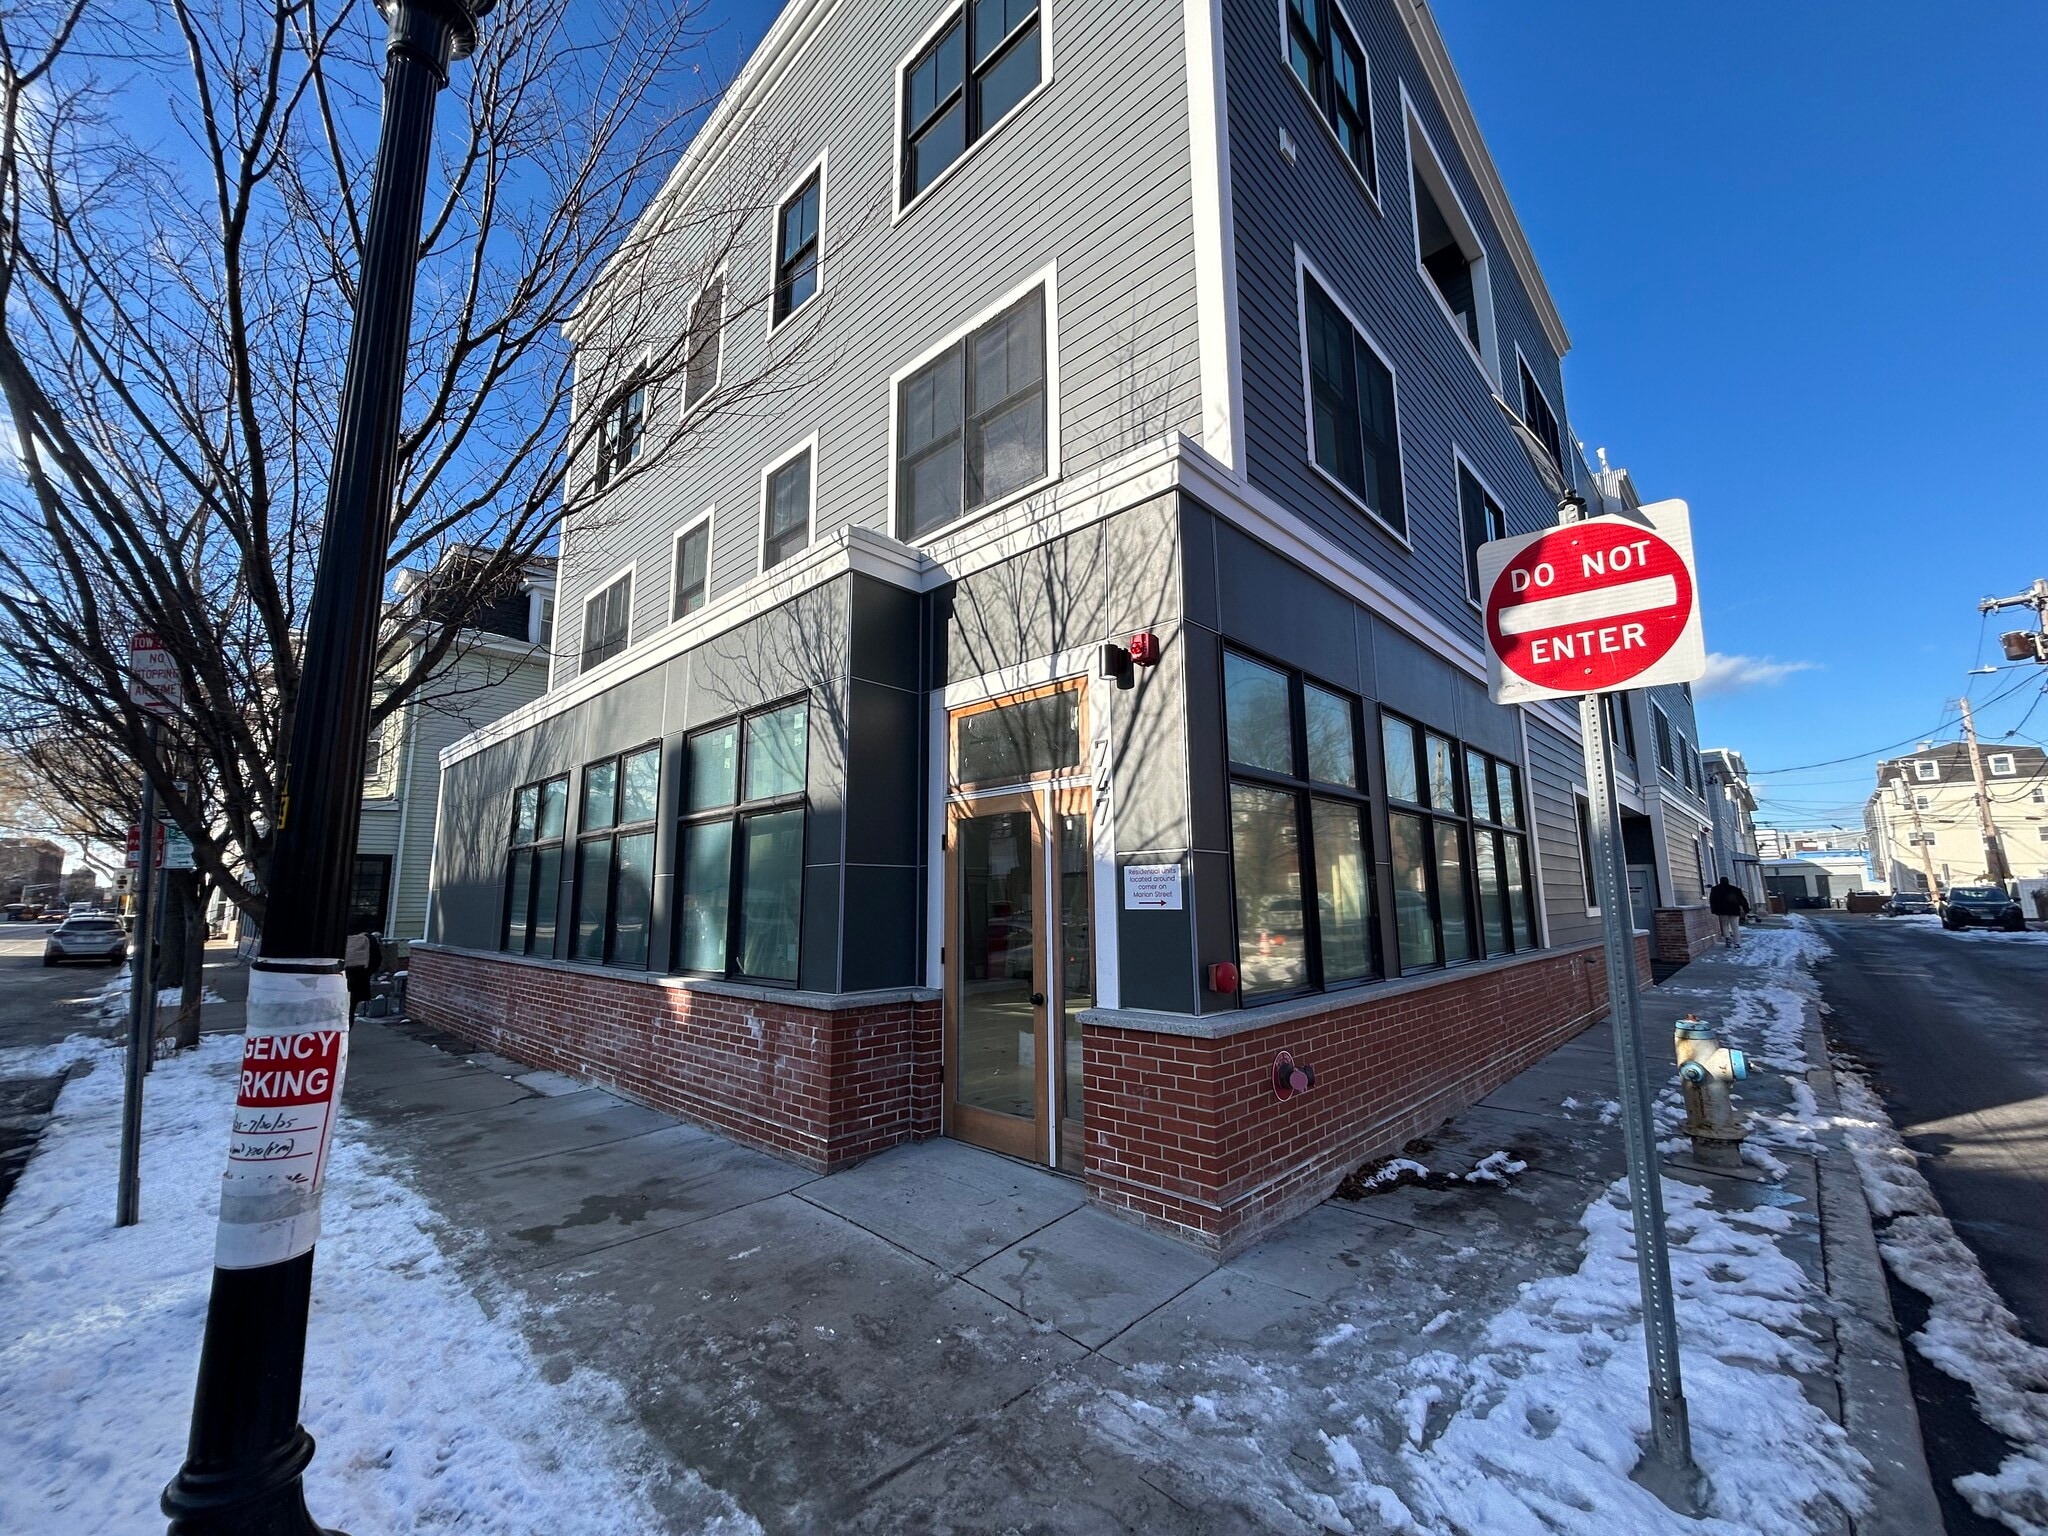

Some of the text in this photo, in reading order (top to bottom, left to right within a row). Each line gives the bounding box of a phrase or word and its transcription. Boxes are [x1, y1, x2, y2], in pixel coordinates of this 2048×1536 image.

[1510, 540, 1650, 593] DO NOT
[133, 637, 153, 649] TOW
[1530, 622, 1647, 665] ENTER
[149, 653, 165, 664] NO
[136, 668, 178, 680] TOPPING
[135, 684, 176, 696] AIME
[1094, 739, 1111, 826] 747
[244, 1031, 337, 1060] GENCY
[239, 1067, 329, 1098] RKING
